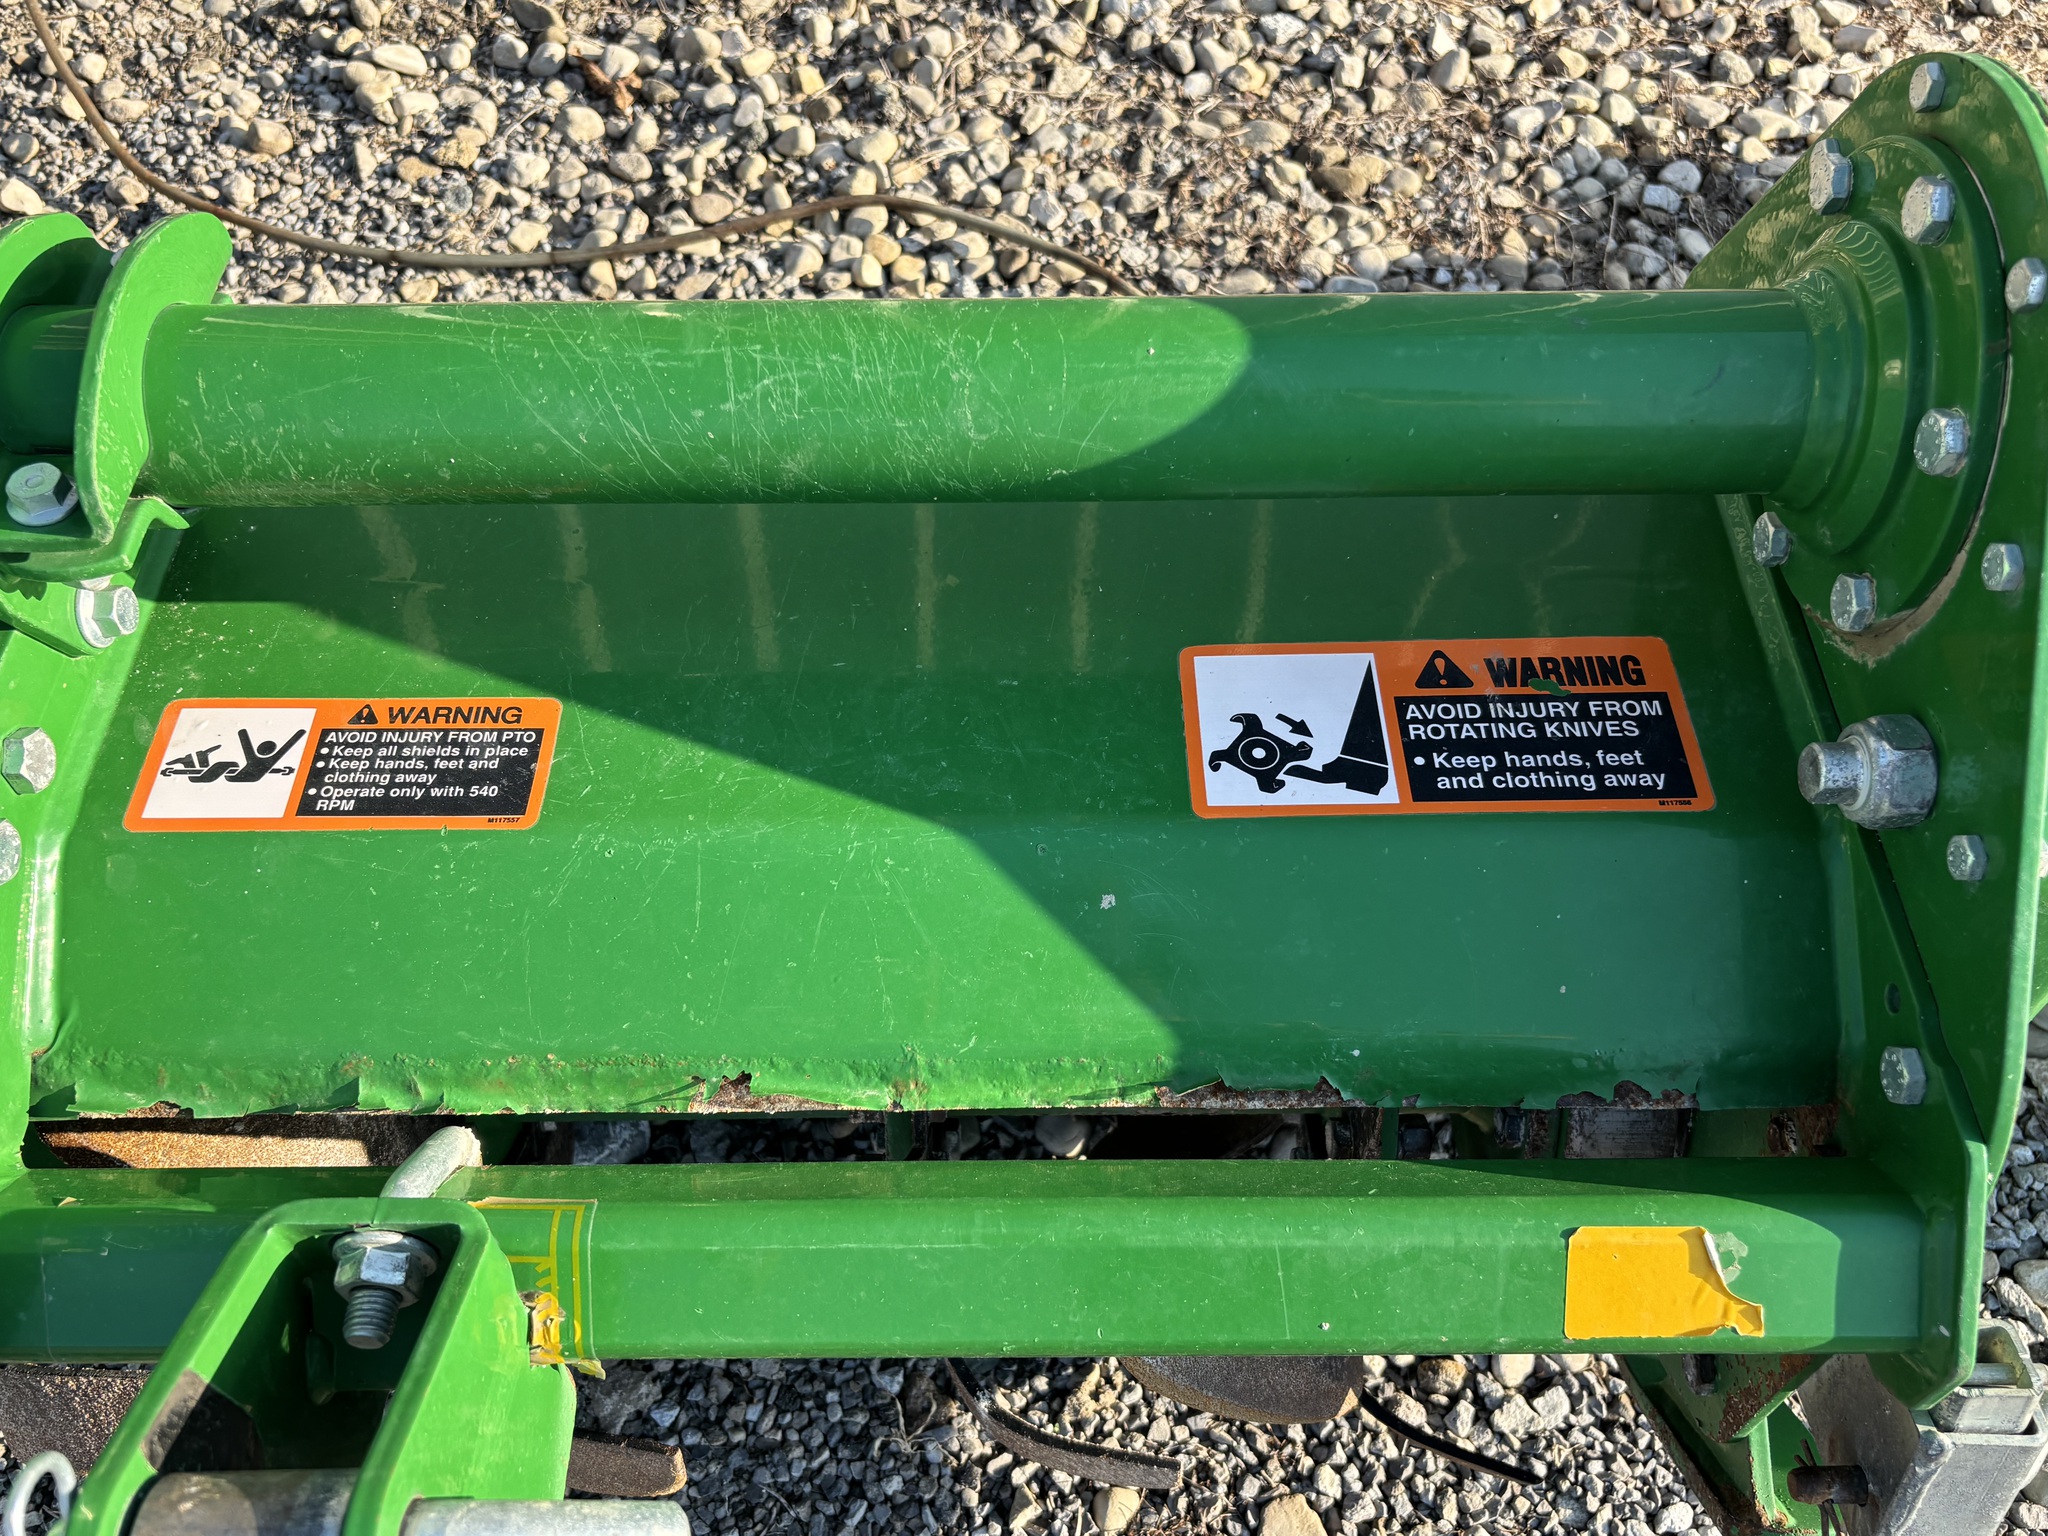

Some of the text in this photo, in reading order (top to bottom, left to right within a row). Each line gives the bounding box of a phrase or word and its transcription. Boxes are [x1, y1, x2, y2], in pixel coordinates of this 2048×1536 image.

[1483, 654, 1648, 688] WARNING
[388, 705, 523, 725] WARNING
[1405, 699, 1663, 720] AVOID INJURY FROM
[324, 731, 536, 744] AVOID INJURY FROM PTO
[1408, 720, 1640, 740] ROTATING KNIVES
[332, 745, 529, 760] Keep all shields in place
[1432, 749, 1645, 772] Keep hands, feet
[328, 758, 500, 772] Keep hands, feet and
[324, 771, 438, 786] clothing away
[1436, 771, 1666, 791] and clothing away
[320, 785, 499, 800] Operate only with 540
[315, 799, 356, 812] RPM
